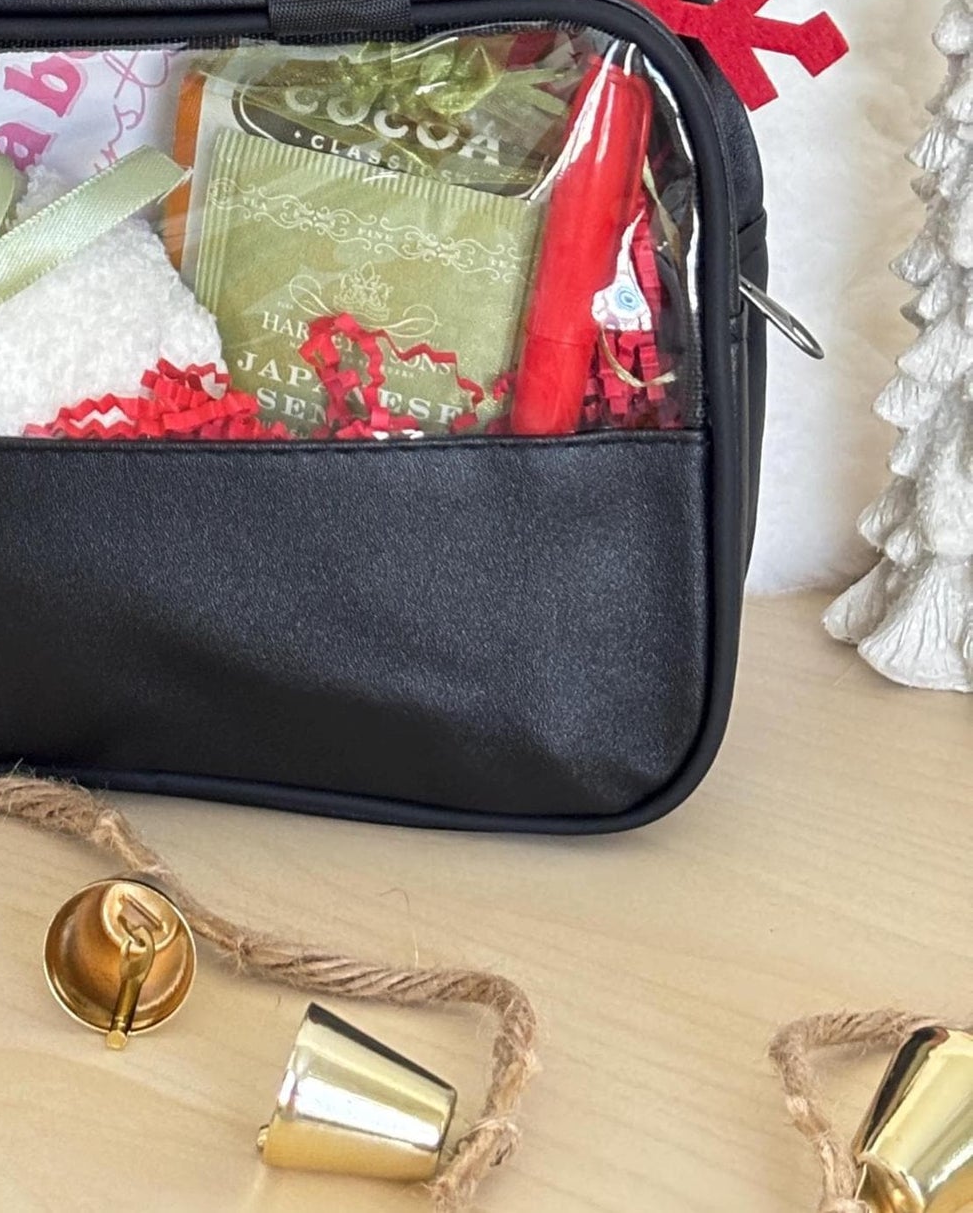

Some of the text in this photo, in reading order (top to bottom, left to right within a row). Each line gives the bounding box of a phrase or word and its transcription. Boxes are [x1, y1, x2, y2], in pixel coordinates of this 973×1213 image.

[284, 83, 501, 166] COCOA
[262, 311, 353, 353] HAREY
[237, 350, 464, 424] JAPESE
